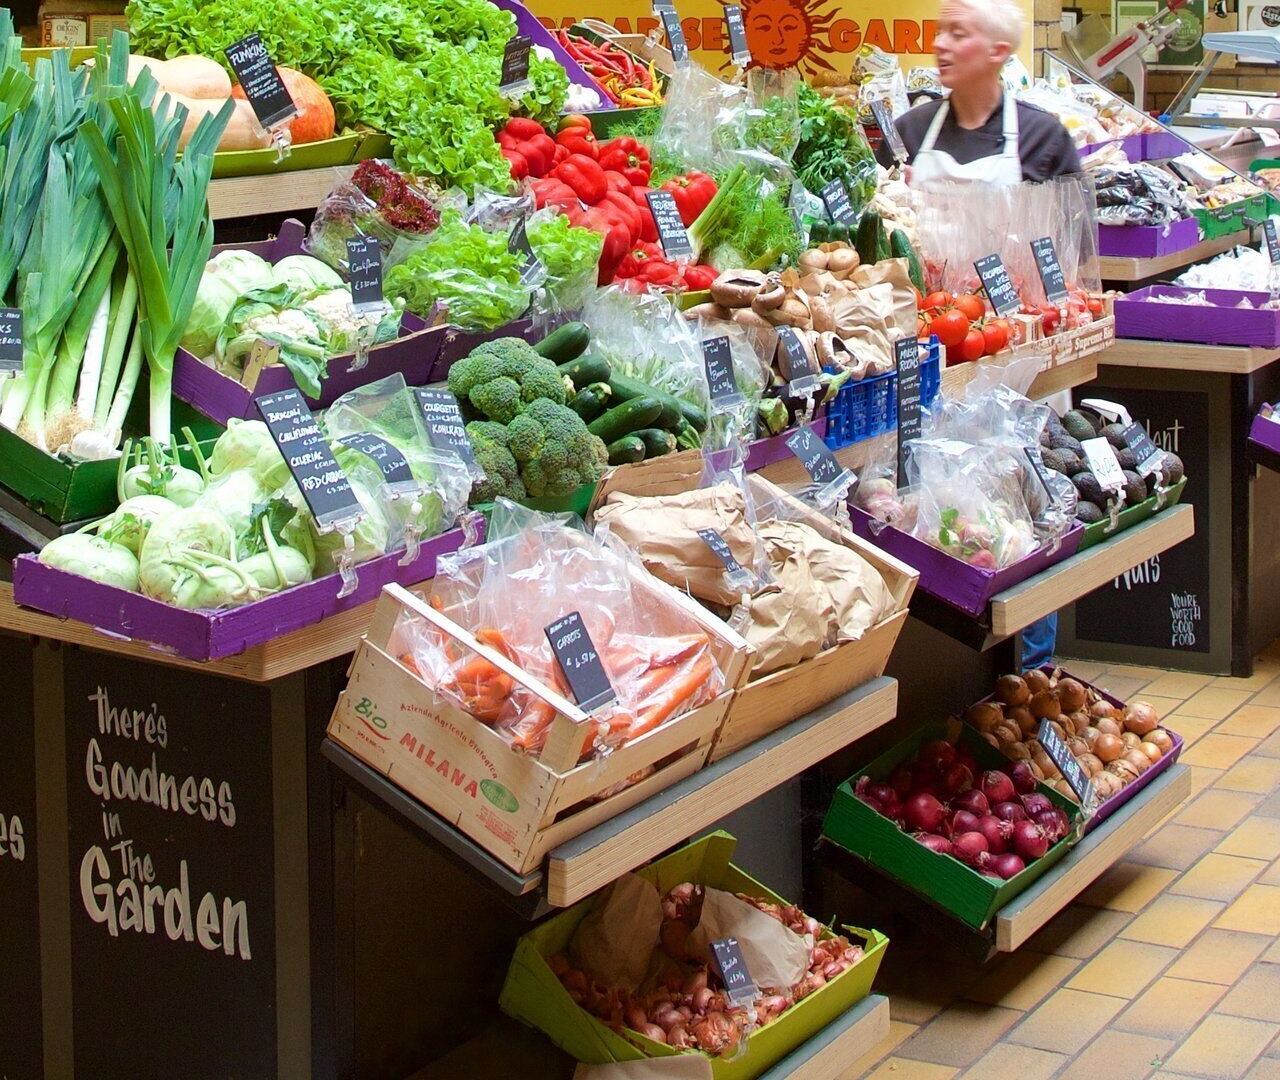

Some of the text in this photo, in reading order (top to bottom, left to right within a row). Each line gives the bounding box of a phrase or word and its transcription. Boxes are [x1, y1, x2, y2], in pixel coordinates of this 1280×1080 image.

[1170, 606, 1201, 621] WORTH
[1171, 590, 1197, 608] YOU'RE
[1172, 620, 1194, 633] GOOD
[1172, 632, 1196, 647] FOOD
[400, 703, 498, 779] Azienda Agricola Biologica
[86, 738, 237, 828] Goodness
[399, 732, 478, 798] MILANA
[102, 802, 123, 841] in
[111, 840, 156, 883] The
[80, 846, 252, 961] Garden
